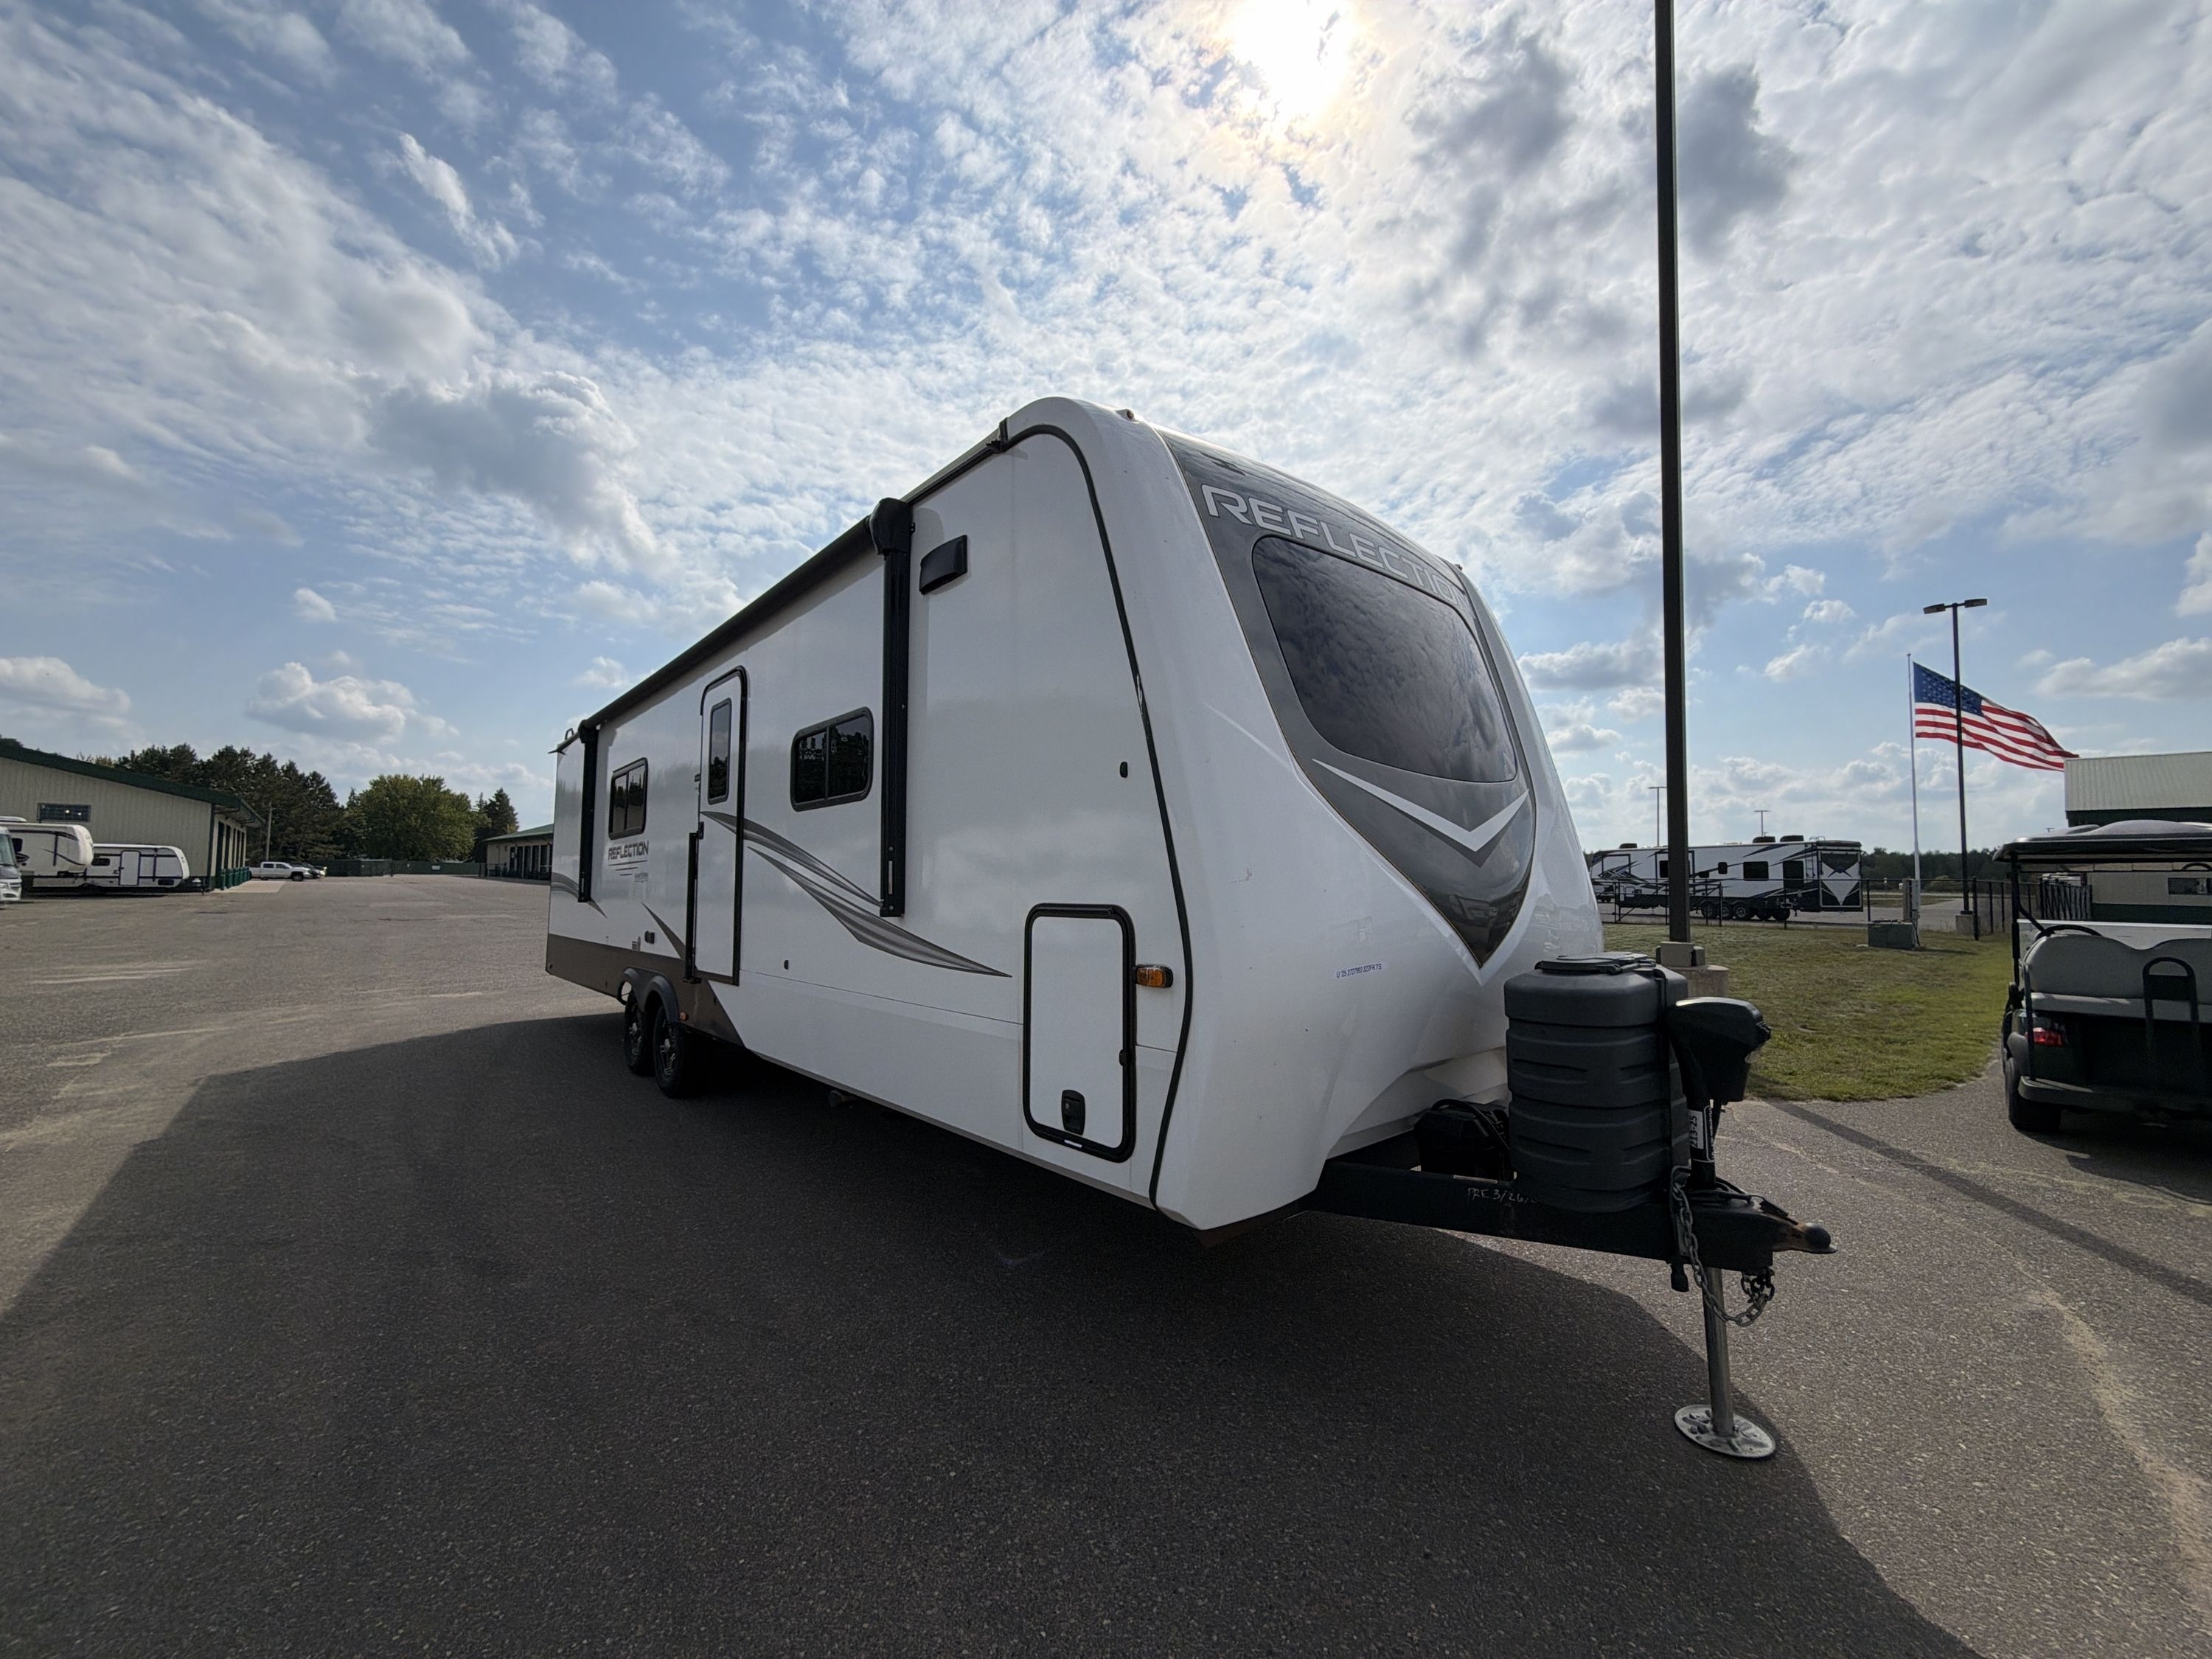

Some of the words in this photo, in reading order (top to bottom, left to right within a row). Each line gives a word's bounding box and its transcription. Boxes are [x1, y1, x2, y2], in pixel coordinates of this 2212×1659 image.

[1201, 484, 1473, 616] REFLECTION
[608, 840, 649, 860] REFLECTION
[1467, 1188, 1489, 1200] PRE
